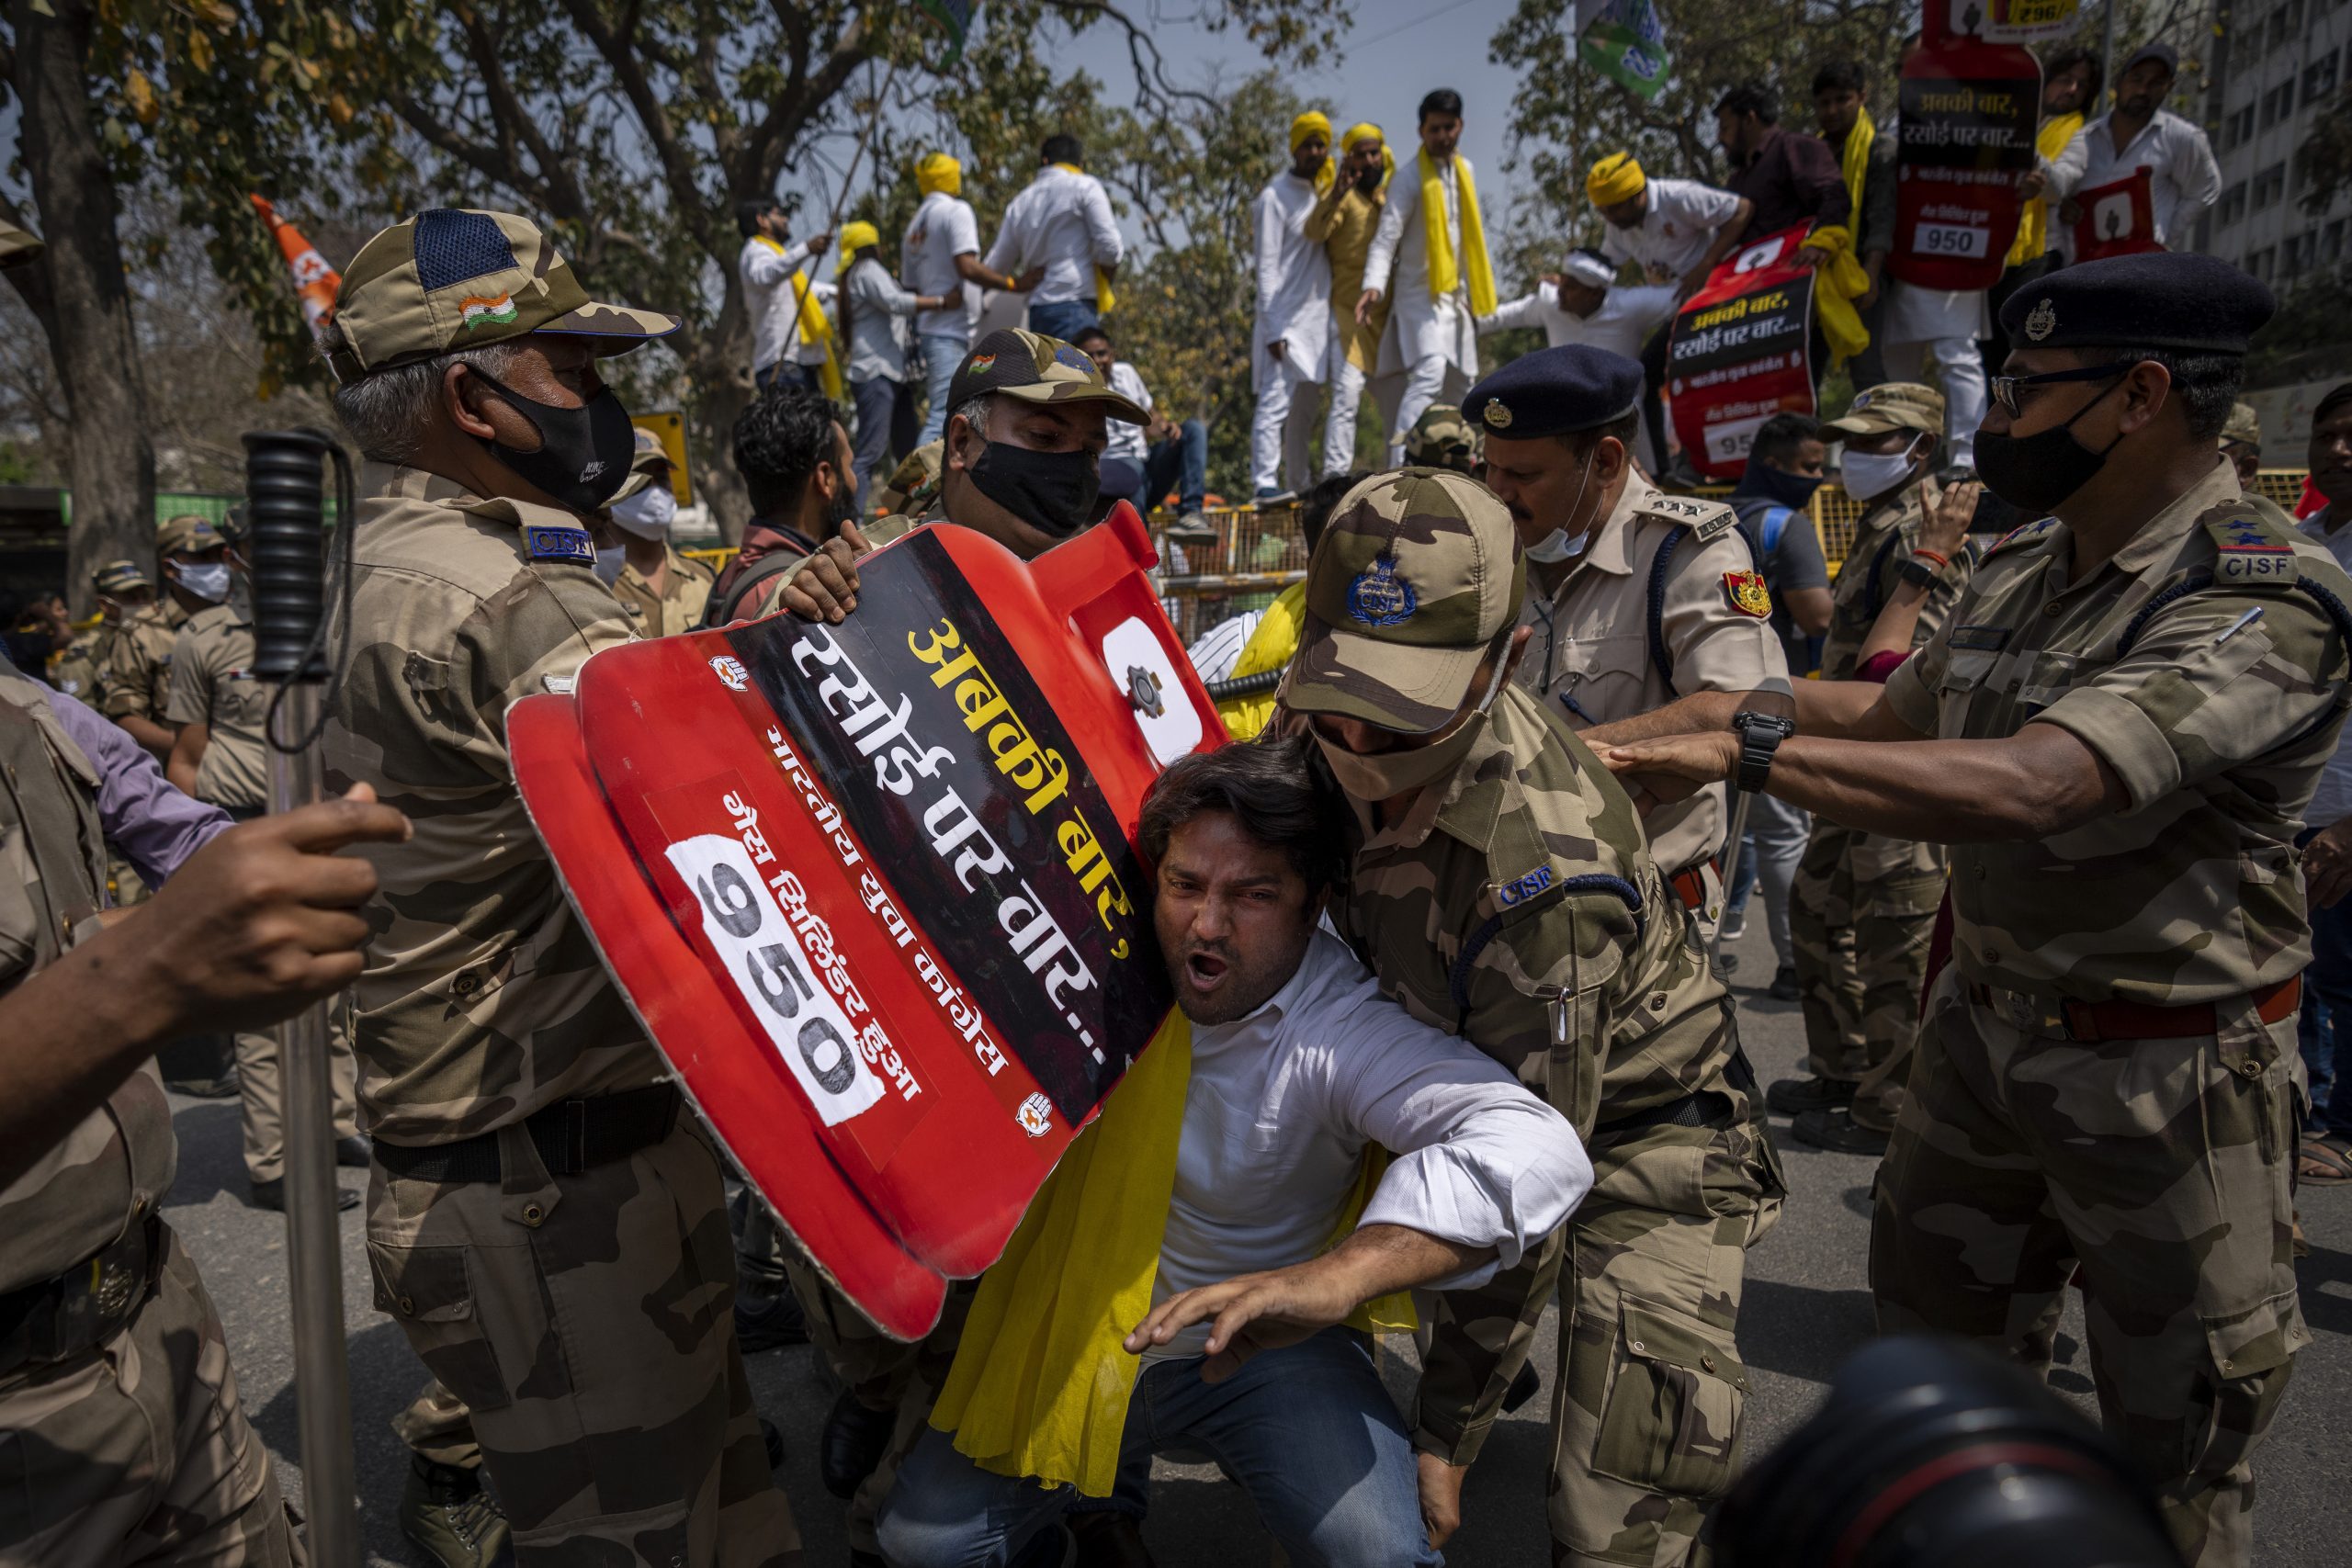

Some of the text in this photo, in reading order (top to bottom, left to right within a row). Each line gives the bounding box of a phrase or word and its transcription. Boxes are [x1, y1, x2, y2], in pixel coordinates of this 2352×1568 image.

[1903, 120, 1951, 148] रसोई
[1952, 126, 1978, 147] पर
[1928, 230, 1973, 253] 950
[1691, 299, 1747, 331] अबकी
[1674, 328, 1721, 359] रसोई
[1723, 323, 1750, 347] पर
[1720, 434, 1753, 455] 95
[584, 461, 605, 474] NIKE
[537, 532, 587, 554] CISF
[2226, 558, 2287, 576] CISF
[908, 617, 1135, 959] अबकी बार,
[791, 623, 1106, 1064] रसोई पर वार...
[767, 725, 1009, 1077] भारतीय युवा कांग्रेस
[1500, 865, 1553, 906] CISF
[723, 791, 922, 1101] गैस सिलिंडर हुआ
[697, 863, 856, 1095] 950
